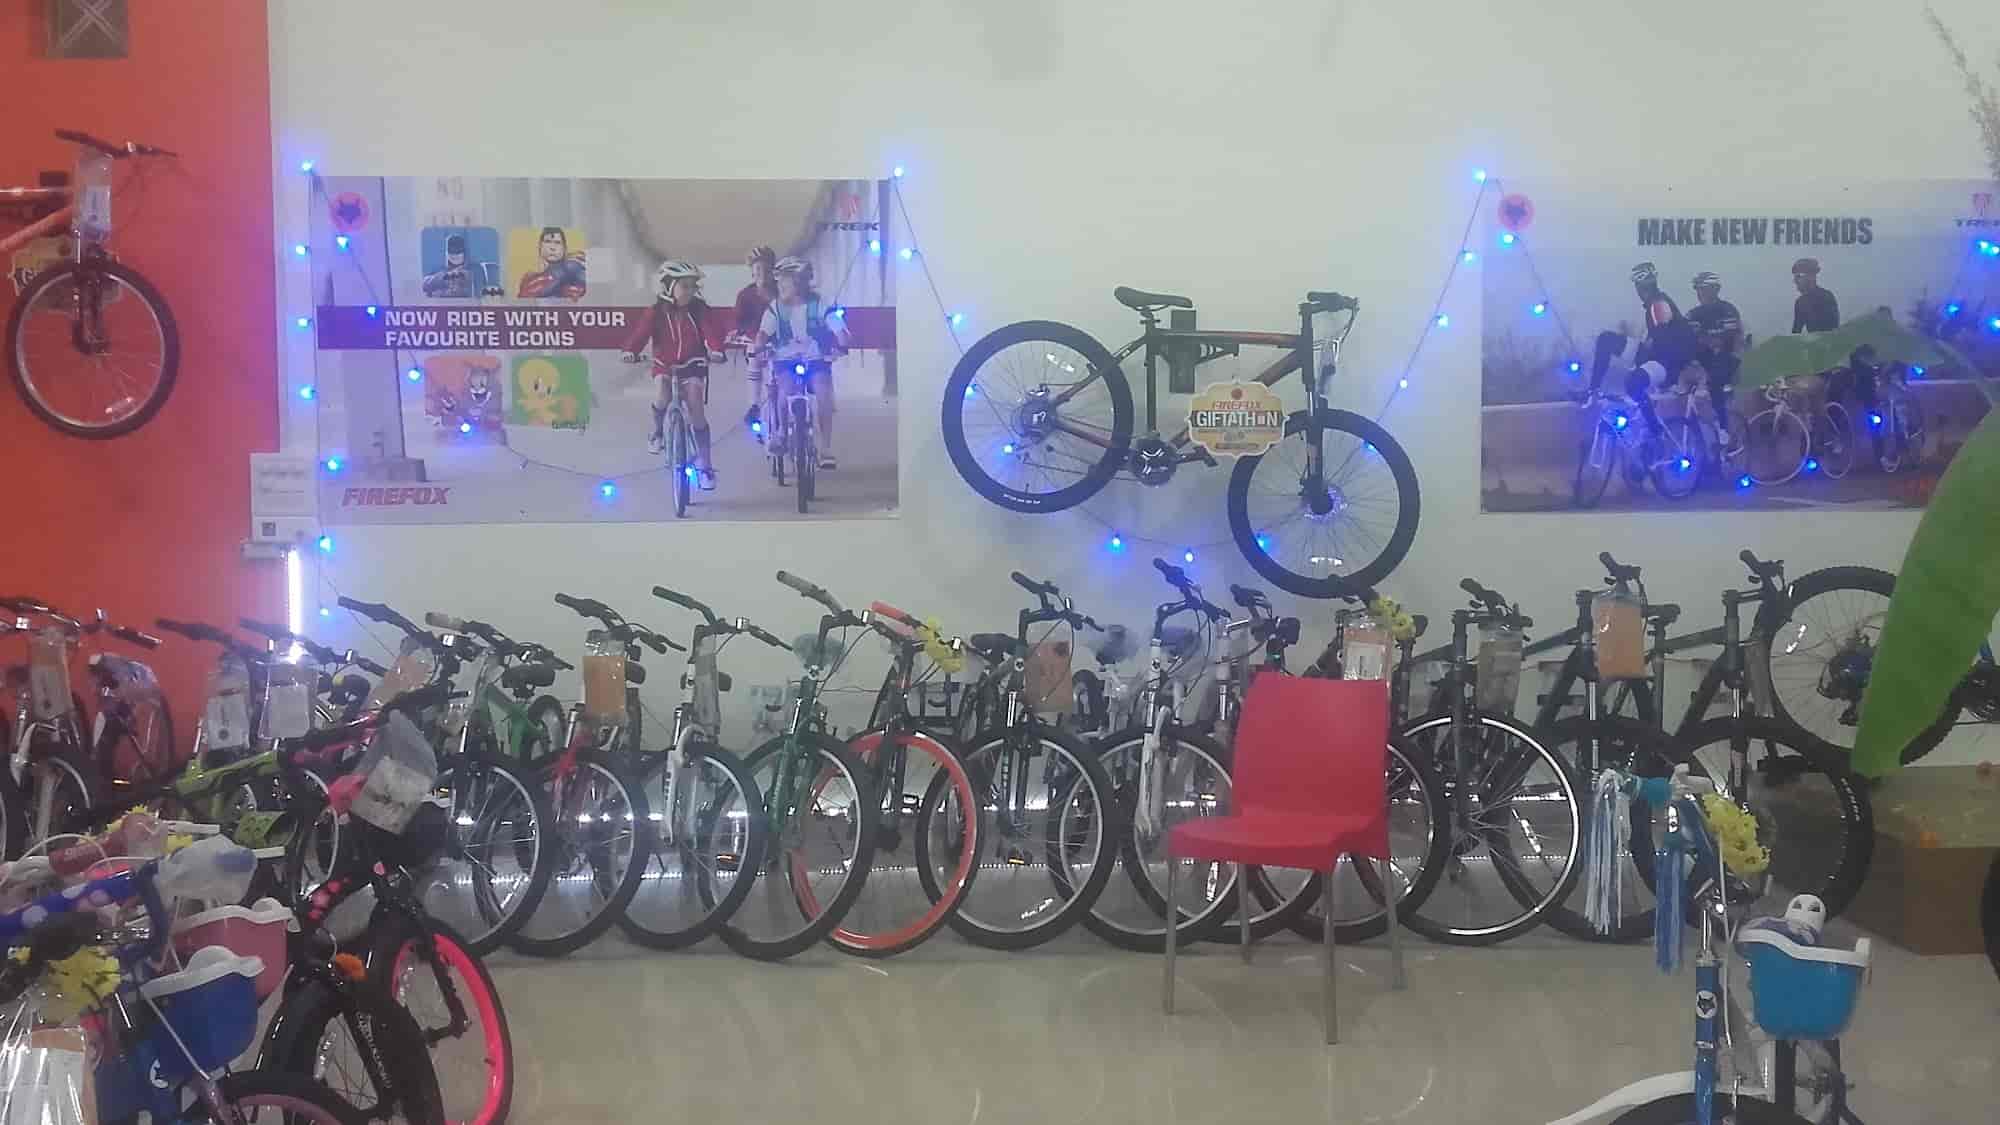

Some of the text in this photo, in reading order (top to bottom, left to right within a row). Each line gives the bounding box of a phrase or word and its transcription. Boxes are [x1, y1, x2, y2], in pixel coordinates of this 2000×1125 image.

[818, 222, 879, 231] TREK
[1638, 218, 1873, 246] MAKE NEW FRIENDS
[384, 311, 626, 327] NOW RIDE WITH YOUR
[384, 331, 575, 346] FAVOURITE ICONS
[341, 487, 450, 506] FIREFOX
